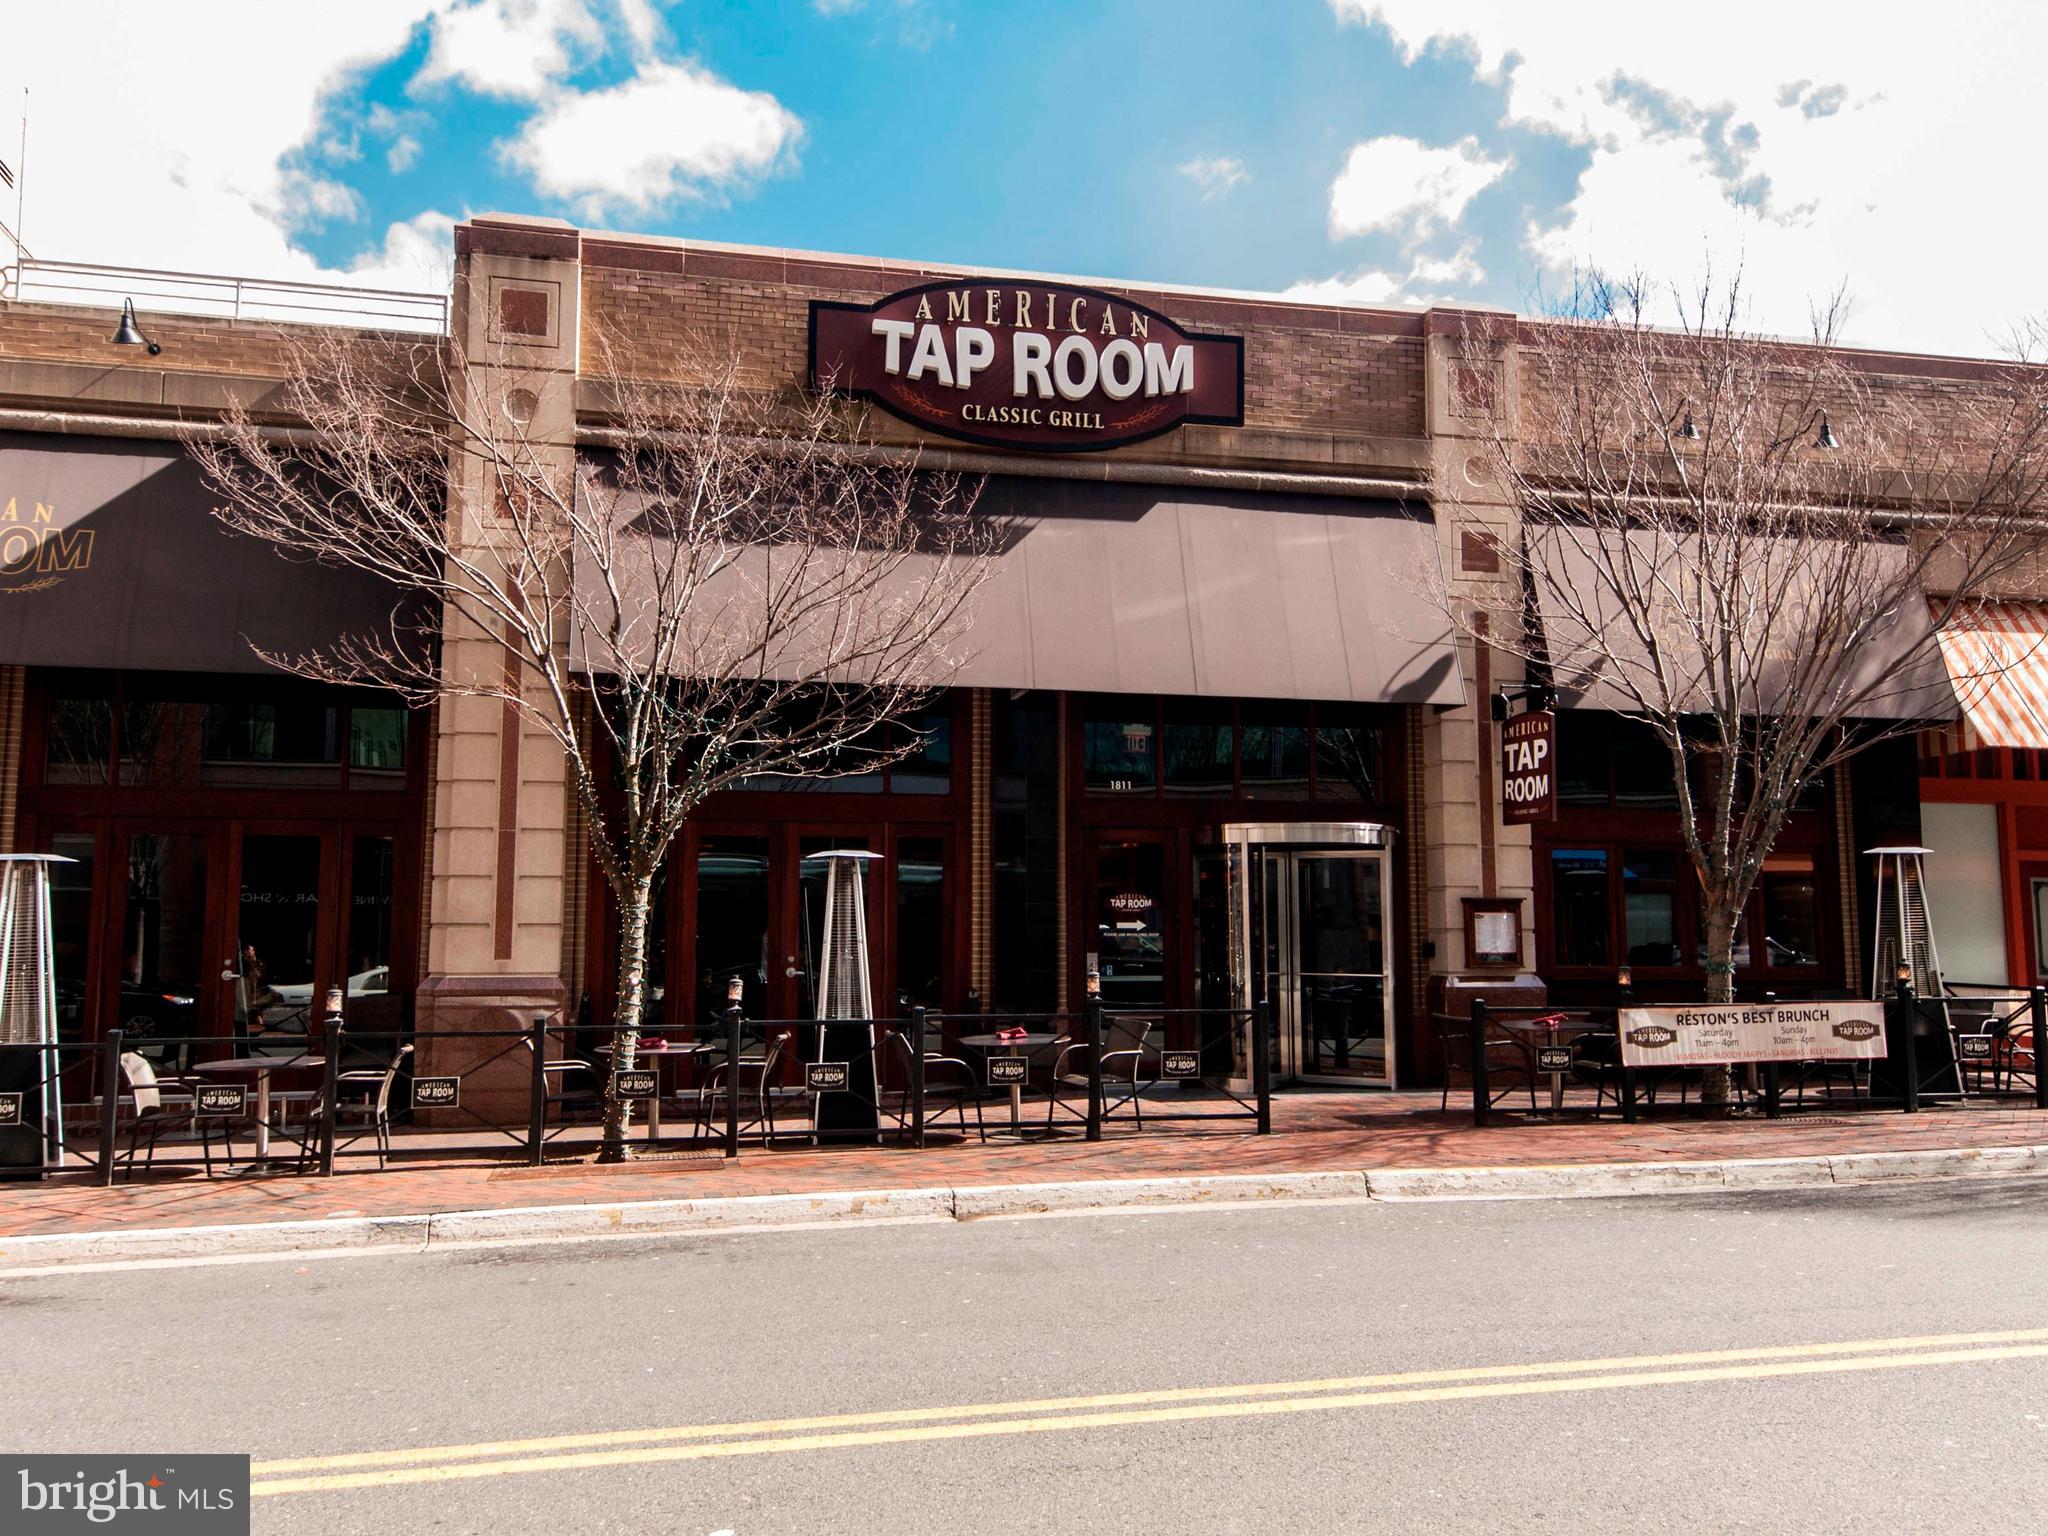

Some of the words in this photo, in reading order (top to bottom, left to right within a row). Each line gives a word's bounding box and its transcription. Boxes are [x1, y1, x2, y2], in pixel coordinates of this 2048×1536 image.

[915, 289, 1149, 338] AMERICAN
[872, 318, 995, 390] TAP
[1013, 331, 1195, 401] ROOM
[962, 404, 1042, 425] CLASSIC
[1049, 410, 1105, 429] GRILL
[1504, 721, 1549, 738] AMERICAN
[1504, 738, 1548, 772] TAP
[1110, 780, 1132, 790] 1811
[1505, 774, 1548, 802] ROOM
[1110, 899, 1126, 908] TAP
[1128, 899, 1152, 908] ROOM
[1676, 1012, 1739, 1026] RESTON'S
[1743, 1011, 1774, 1025] BEST
[1777, 1009, 1829, 1023] BRUNCH
[1698, 1028, 1733, 1038] Saturday
[1781, 1025, 1807, 1035] Sunday
[1839, 1027, 1852, 1035] TAP
[1854, 1026, 1874, 1036] ROOM
[1633, 1033, 1648, 1041] TAP
[1650, 1033, 1671, 1042] ROOM
[1695, 1039, 1714, 1047] 11am
[1722, 1038, 1740, 1047] 4pm
[1801, 1035, 1816, 1045] 4pm
[1178, 1061, 1196, 1069] ROOM
[992, 1066, 1004, 1075] TAP
[1005, 1066, 1024, 1075] ROOM
[811, 1072, 823, 1081] TAP
[825, 1072, 844, 1081] ROOM
[620, 1080, 632, 1089] TAP
[634, 1080, 654, 1089] ROOM
[417, 1088, 431, 1097] TAP
[432, 1088, 454, 1097] ROOM
[202, 1096, 216, 1104] TAP
[218, 1096, 241, 1105] ROOM
